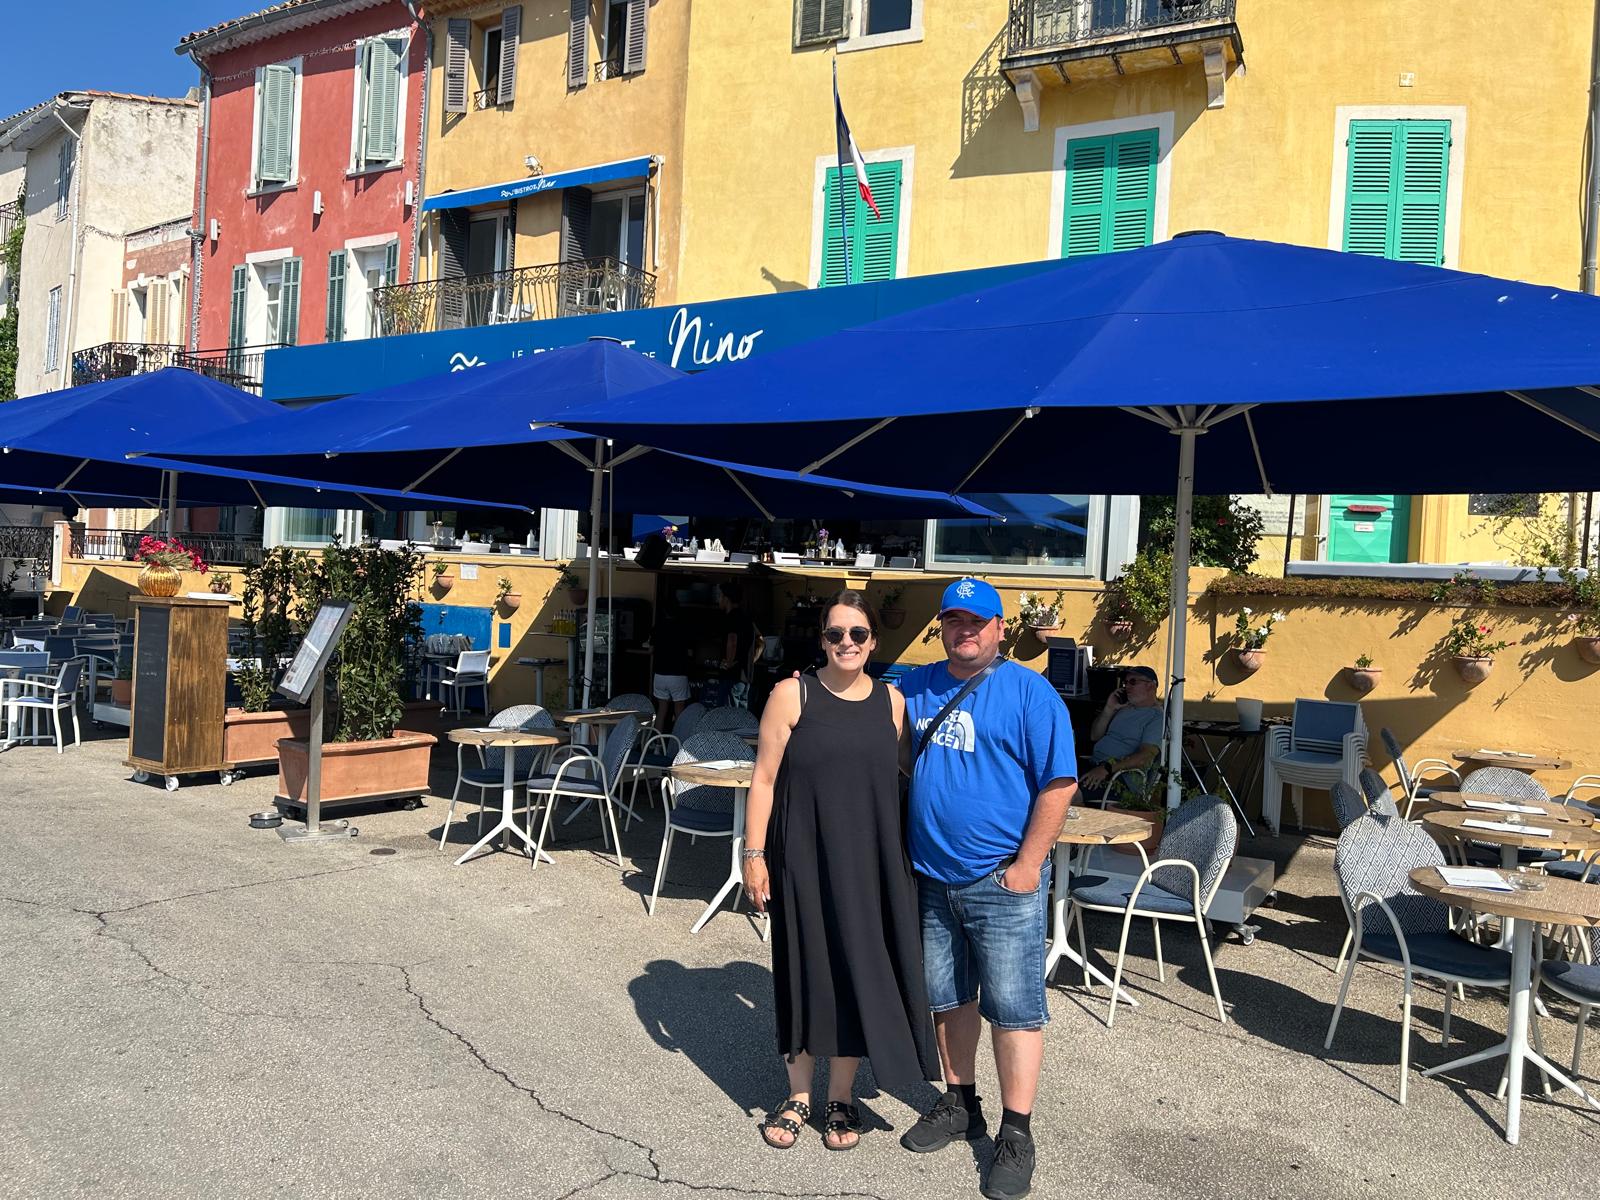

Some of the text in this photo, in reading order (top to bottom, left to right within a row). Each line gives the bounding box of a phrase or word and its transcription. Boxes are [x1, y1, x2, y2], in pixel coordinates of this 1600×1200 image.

[668, 307, 764, 369] Nino
[916, 718, 955, 736] NOTH
[930, 731, 954, 747] ACE
